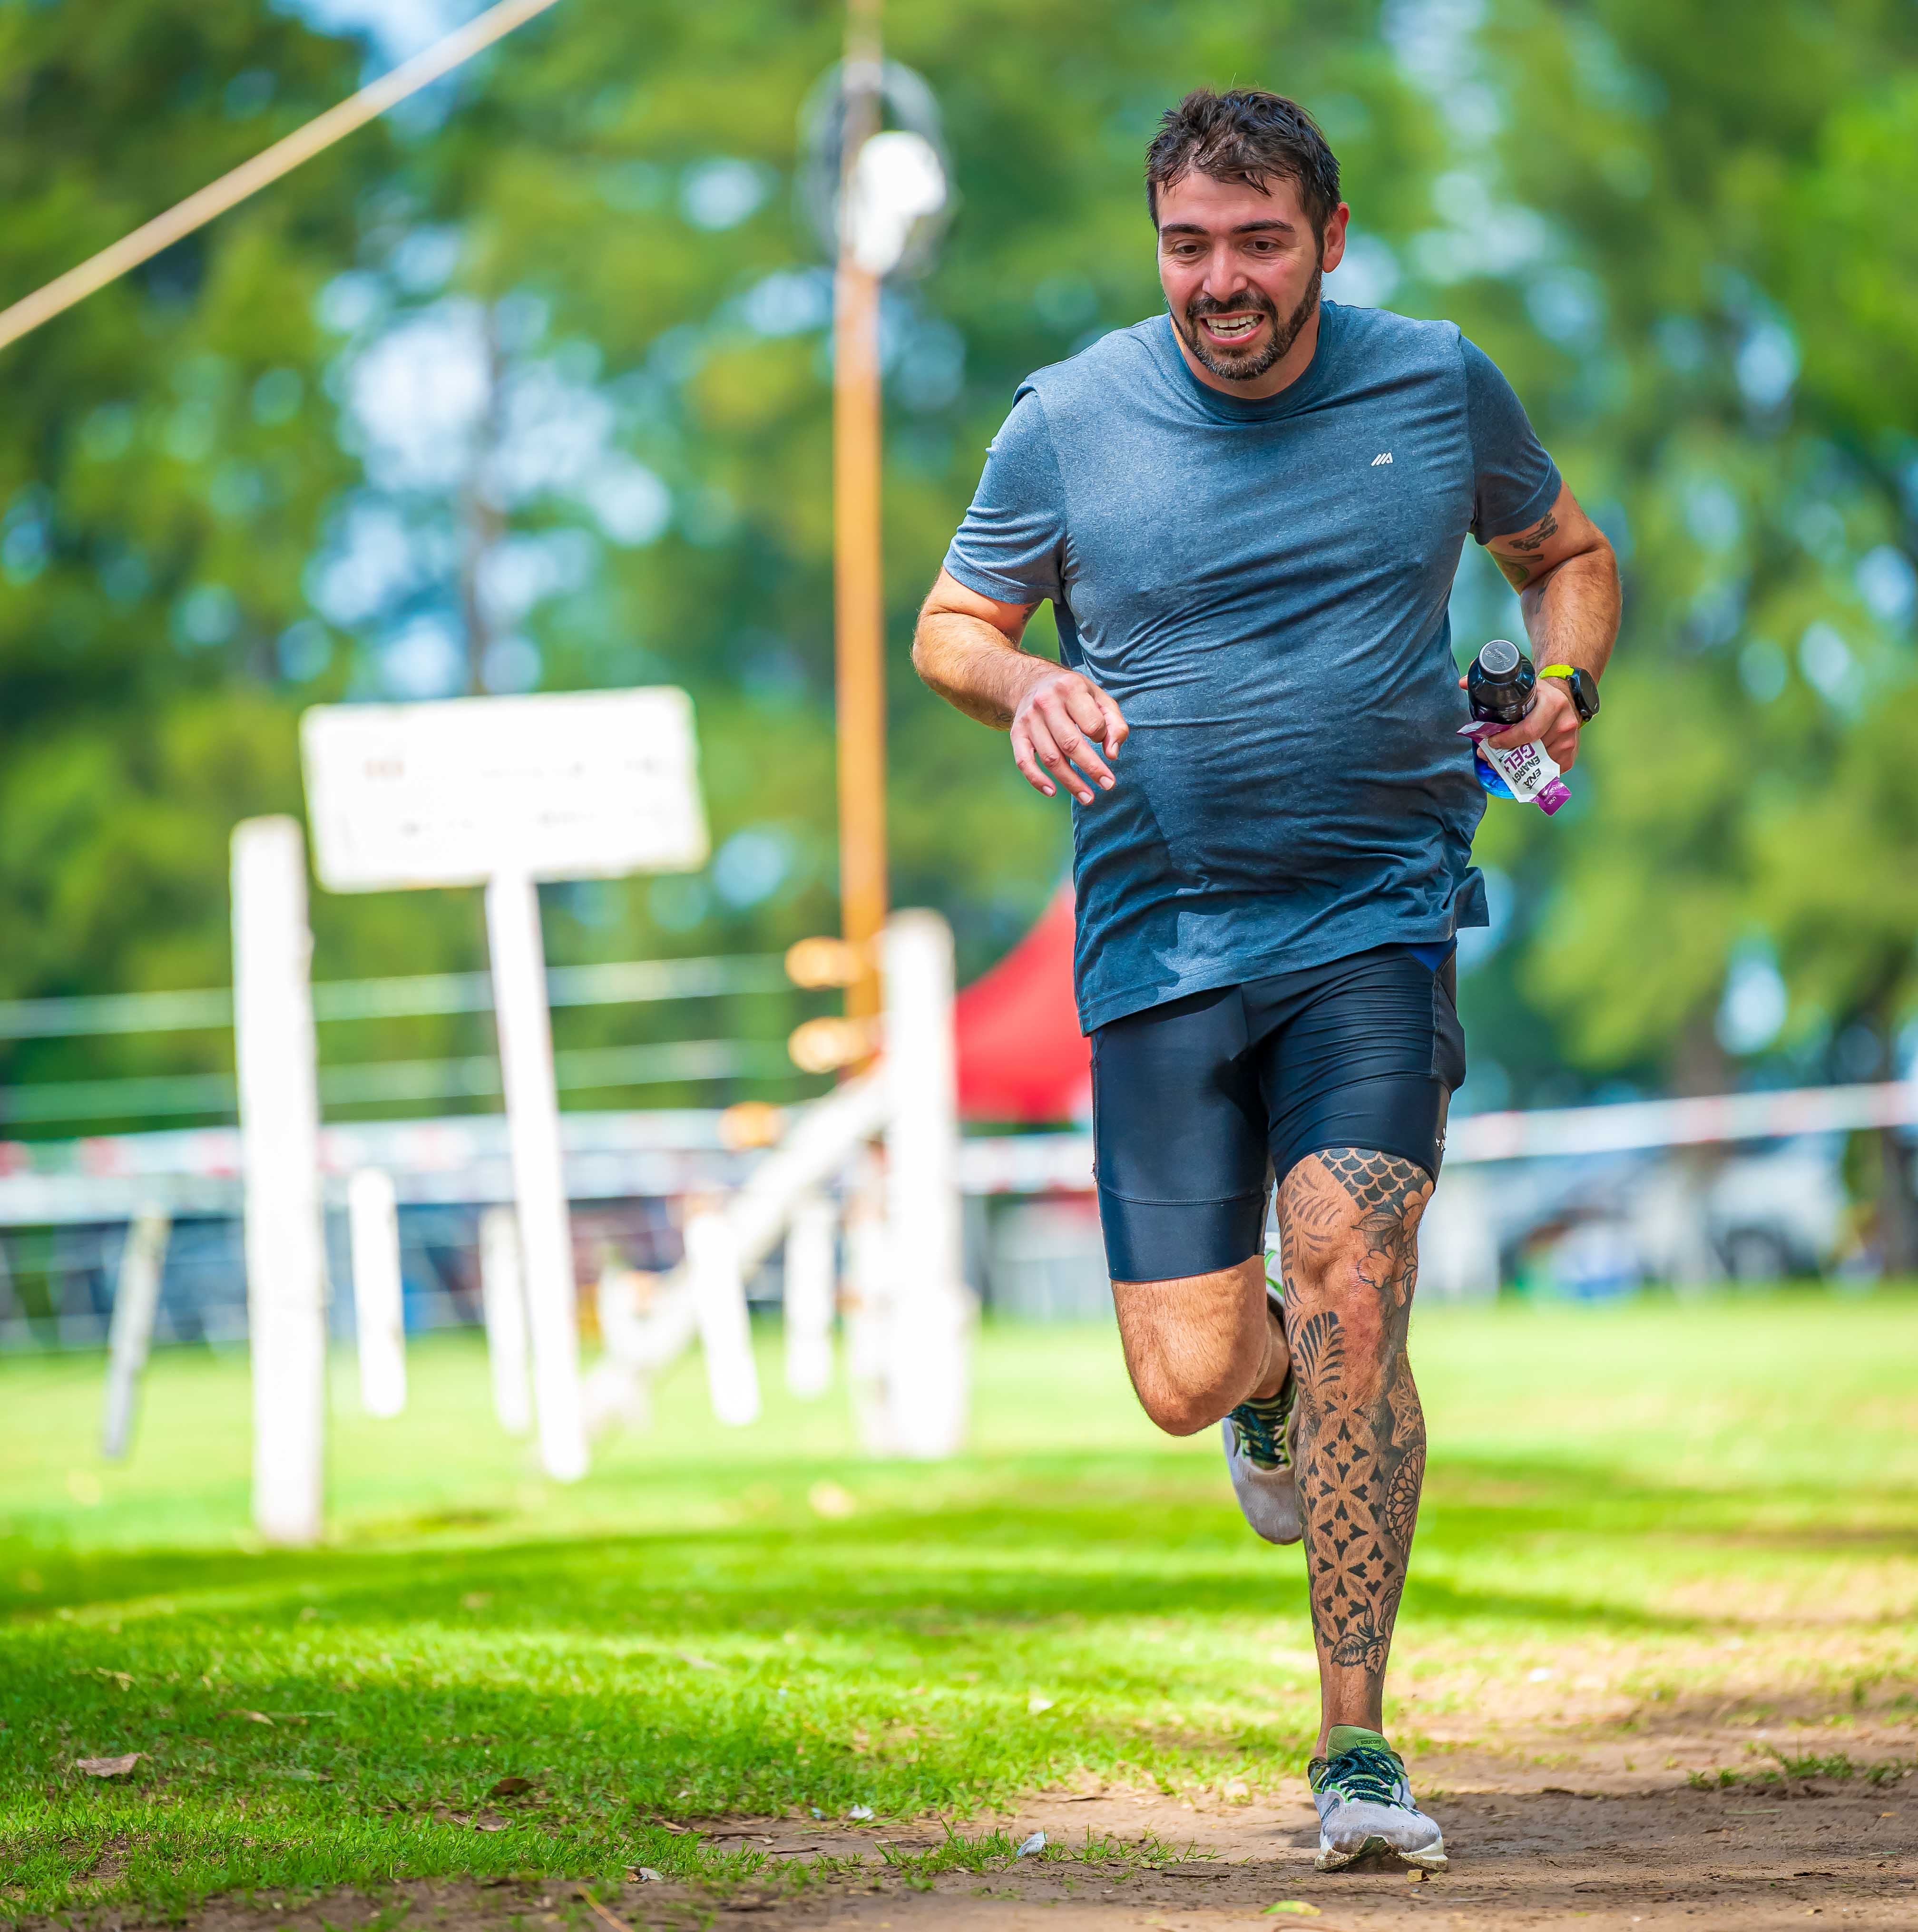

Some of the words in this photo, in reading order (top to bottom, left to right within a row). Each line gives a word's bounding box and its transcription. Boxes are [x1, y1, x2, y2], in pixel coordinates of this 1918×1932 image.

[1494, 648, 1510, 662] Company
[1503, 742, 1536, 773] GEL+
[1512, 755, 1541, 785] ENARGY
[1522, 768, 1542, 787] ENA
[1547, 796, 1557, 805] UVA
